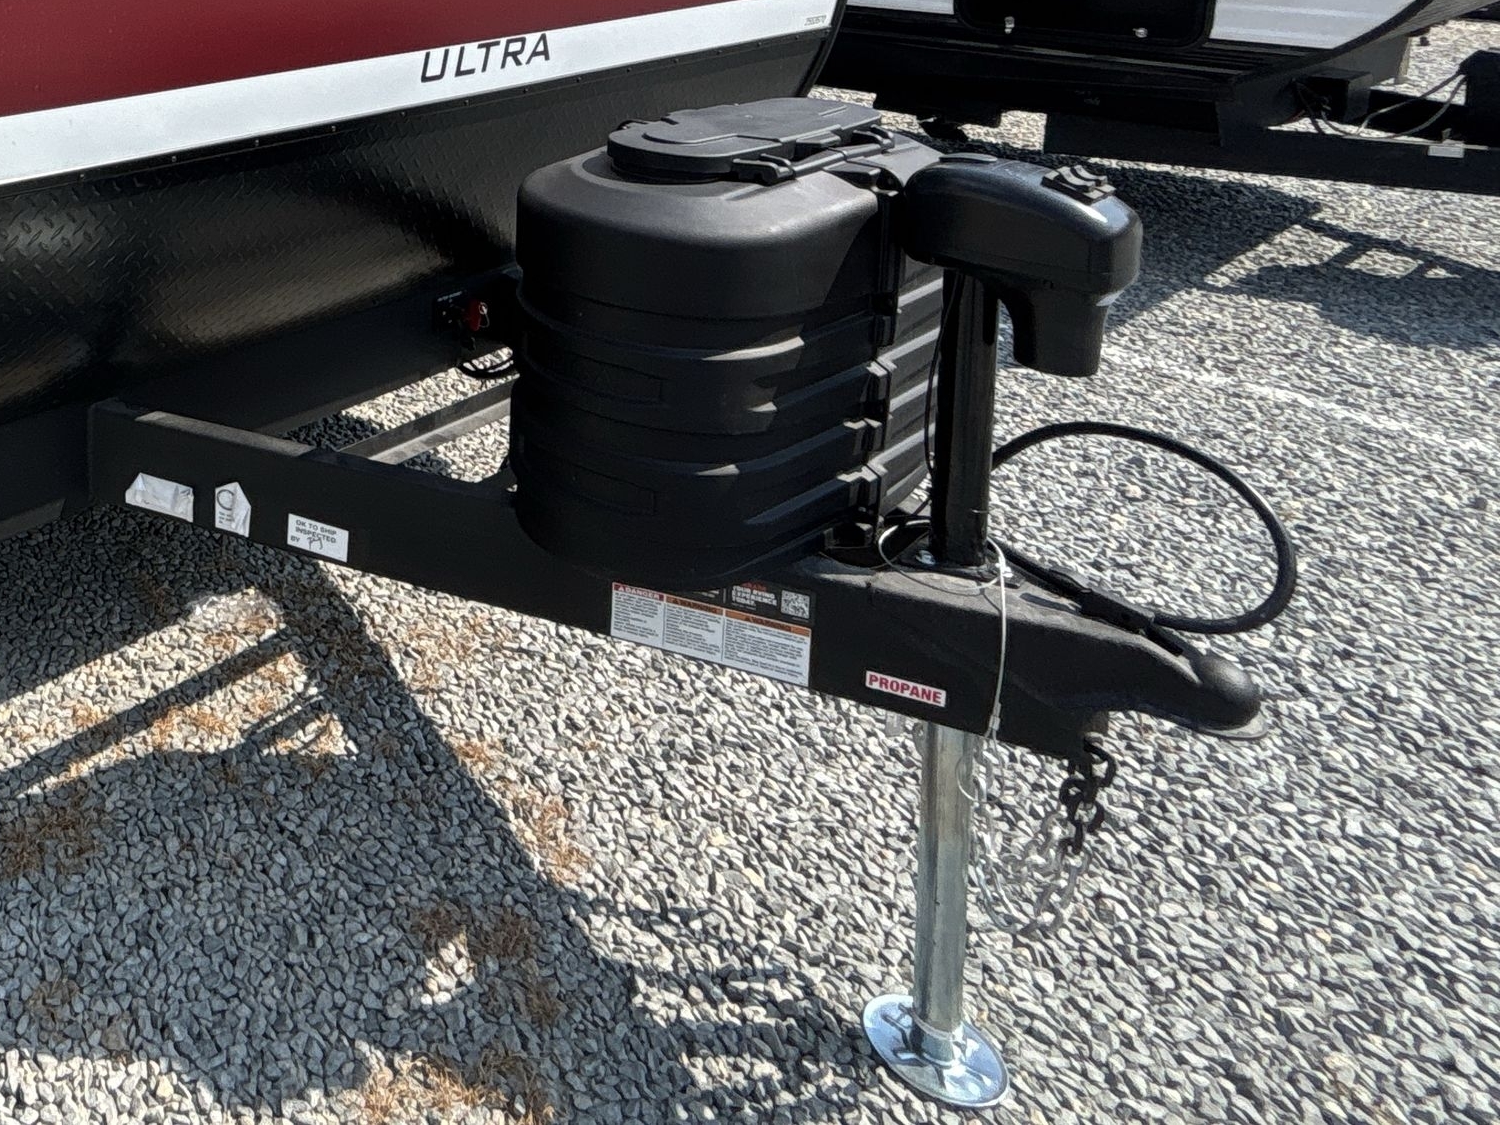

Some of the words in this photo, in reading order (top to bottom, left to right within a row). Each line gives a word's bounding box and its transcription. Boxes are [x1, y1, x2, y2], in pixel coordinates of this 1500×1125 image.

[420, 32, 551, 83] ULTRA
[295, 519, 307, 527] OK
[308, 523, 318, 531] TO
[319, 526, 337, 536] SHIP
[295, 526, 337, 544] INSPECTED
[625, 587, 660, 600] DANGER
[868, 674, 942, 704] PROPANE
